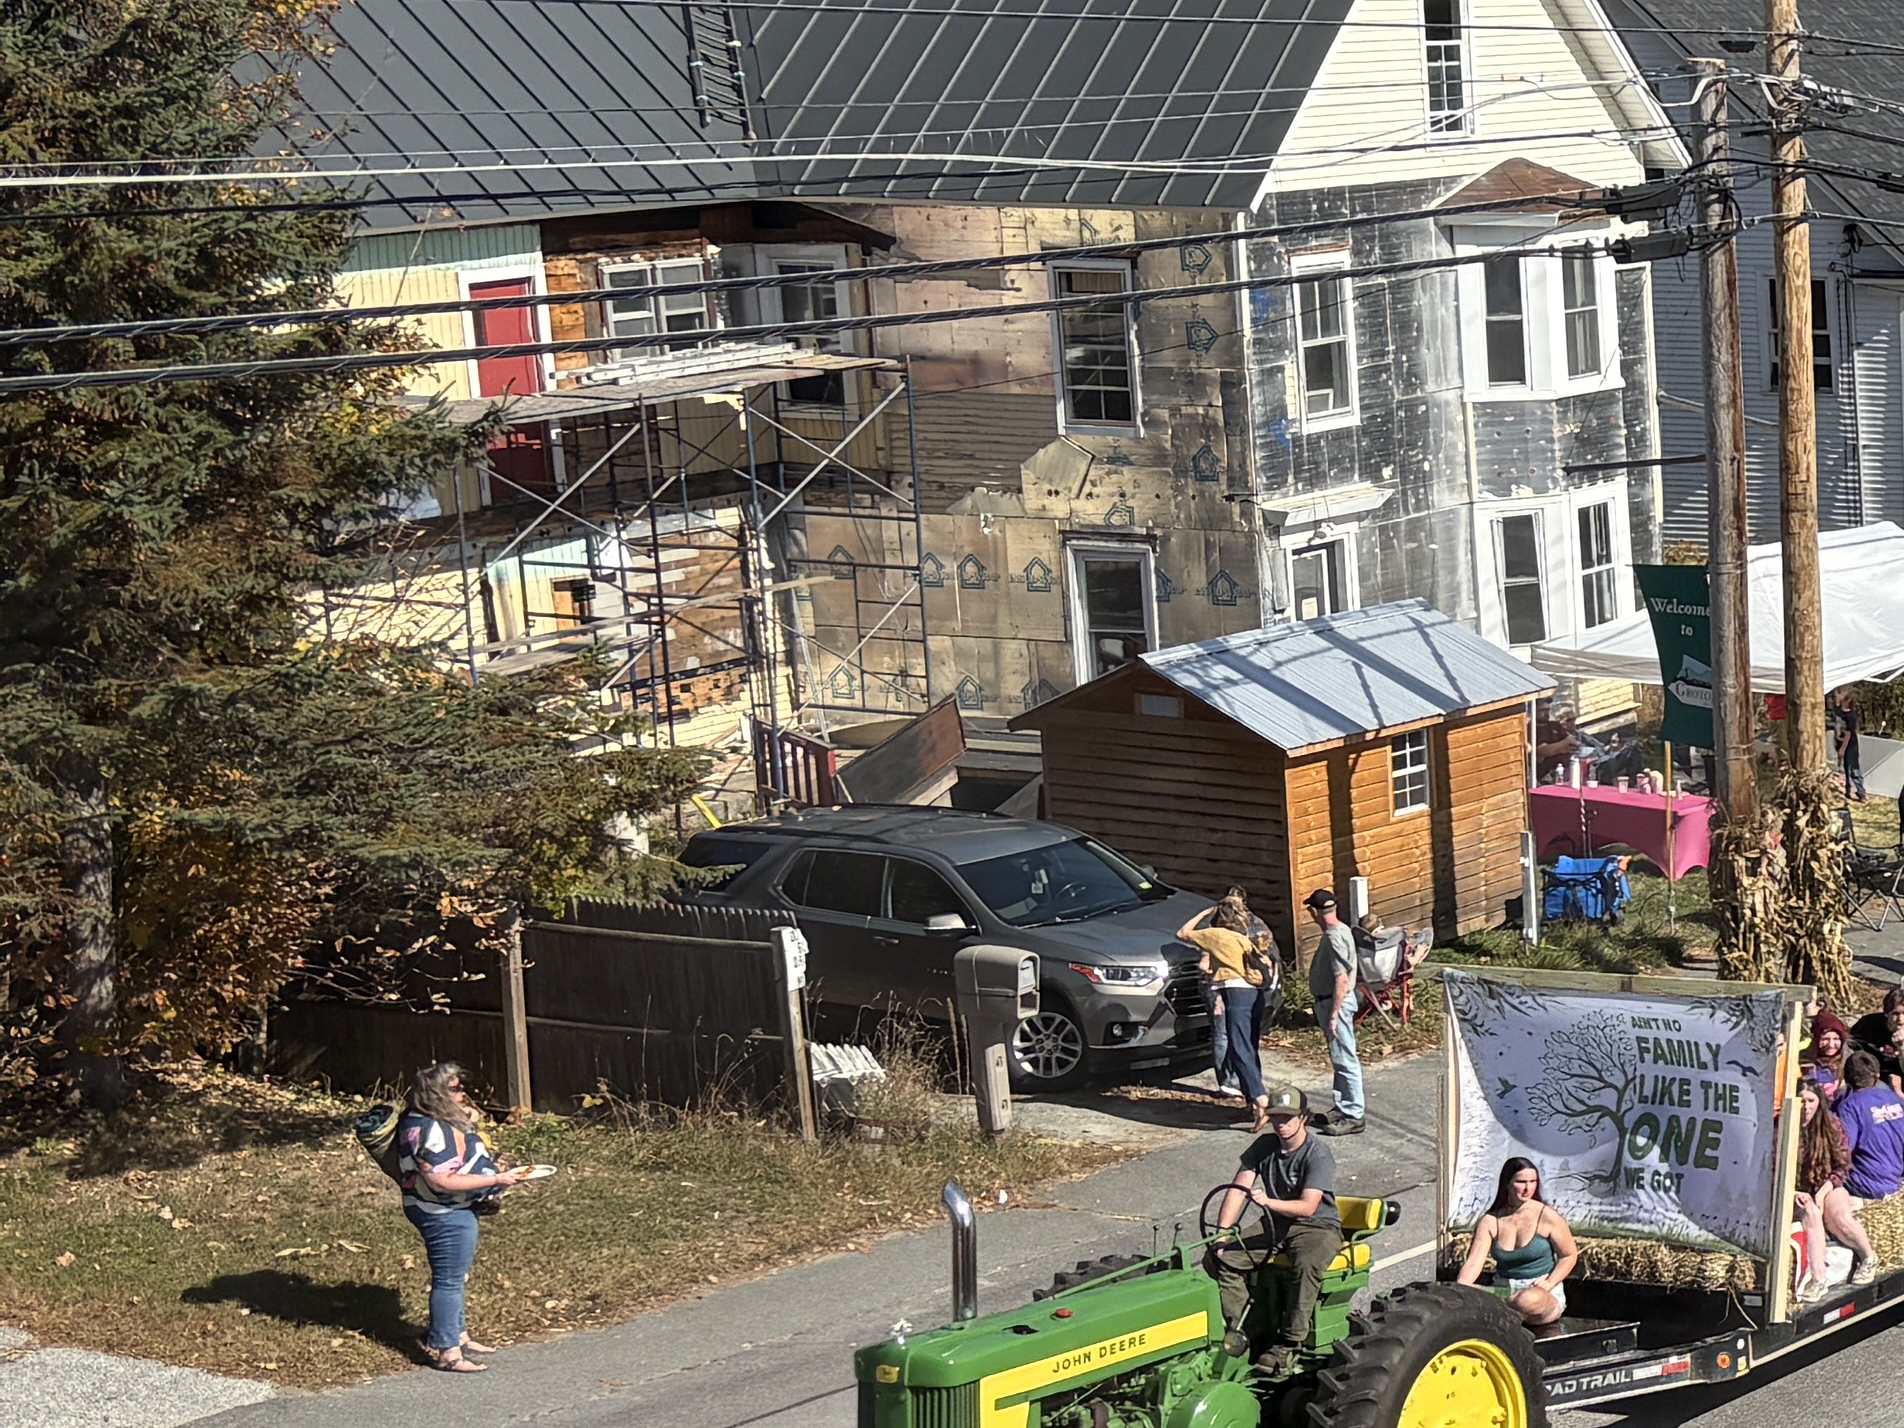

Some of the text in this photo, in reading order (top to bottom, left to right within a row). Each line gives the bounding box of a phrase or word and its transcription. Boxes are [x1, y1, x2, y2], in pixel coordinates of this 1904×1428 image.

[1681, 624, 1694, 637] to
[1661, 1018, 1682, 1033] NO
[1636, 1036, 1721, 1072] FAMILY
[1638, 1074, 1741, 1116] LIKE THE
[1627, 1112, 1724, 1171] ONE
[1624, 1166, 1684, 1195] WE GOT
[1052, 1333, 1147, 1374] JOHN DEERE
[1580, 1370, 1631, 1391] TRAIL
